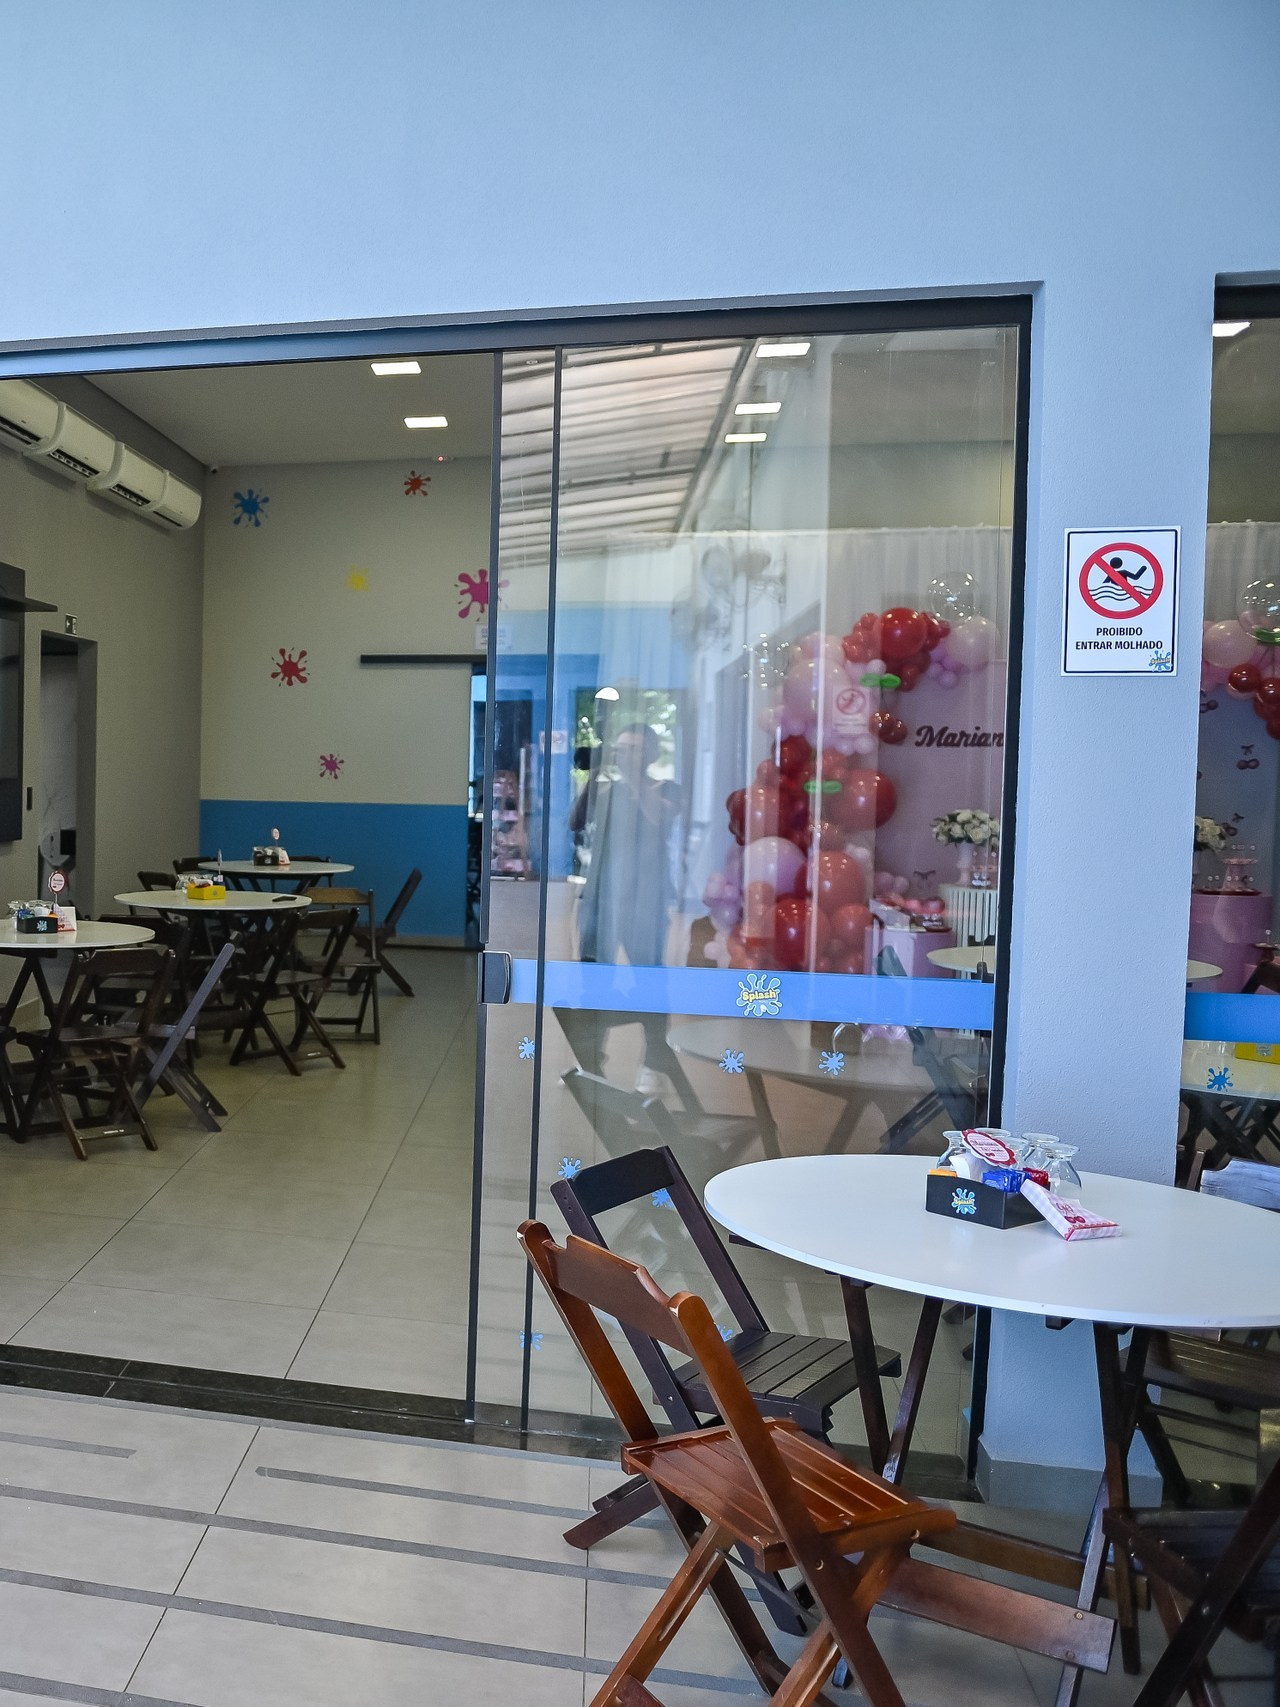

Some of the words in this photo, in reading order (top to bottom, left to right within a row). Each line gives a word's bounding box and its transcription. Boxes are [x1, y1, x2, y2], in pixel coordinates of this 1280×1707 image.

[1096, 627, 1143, 636] PROIBIDO
[1075, 641, 1113, 650] ENTRAR
[1114, 640, 1163, 650] MOLHADO
[742, 988, 777, 1003] Splash
